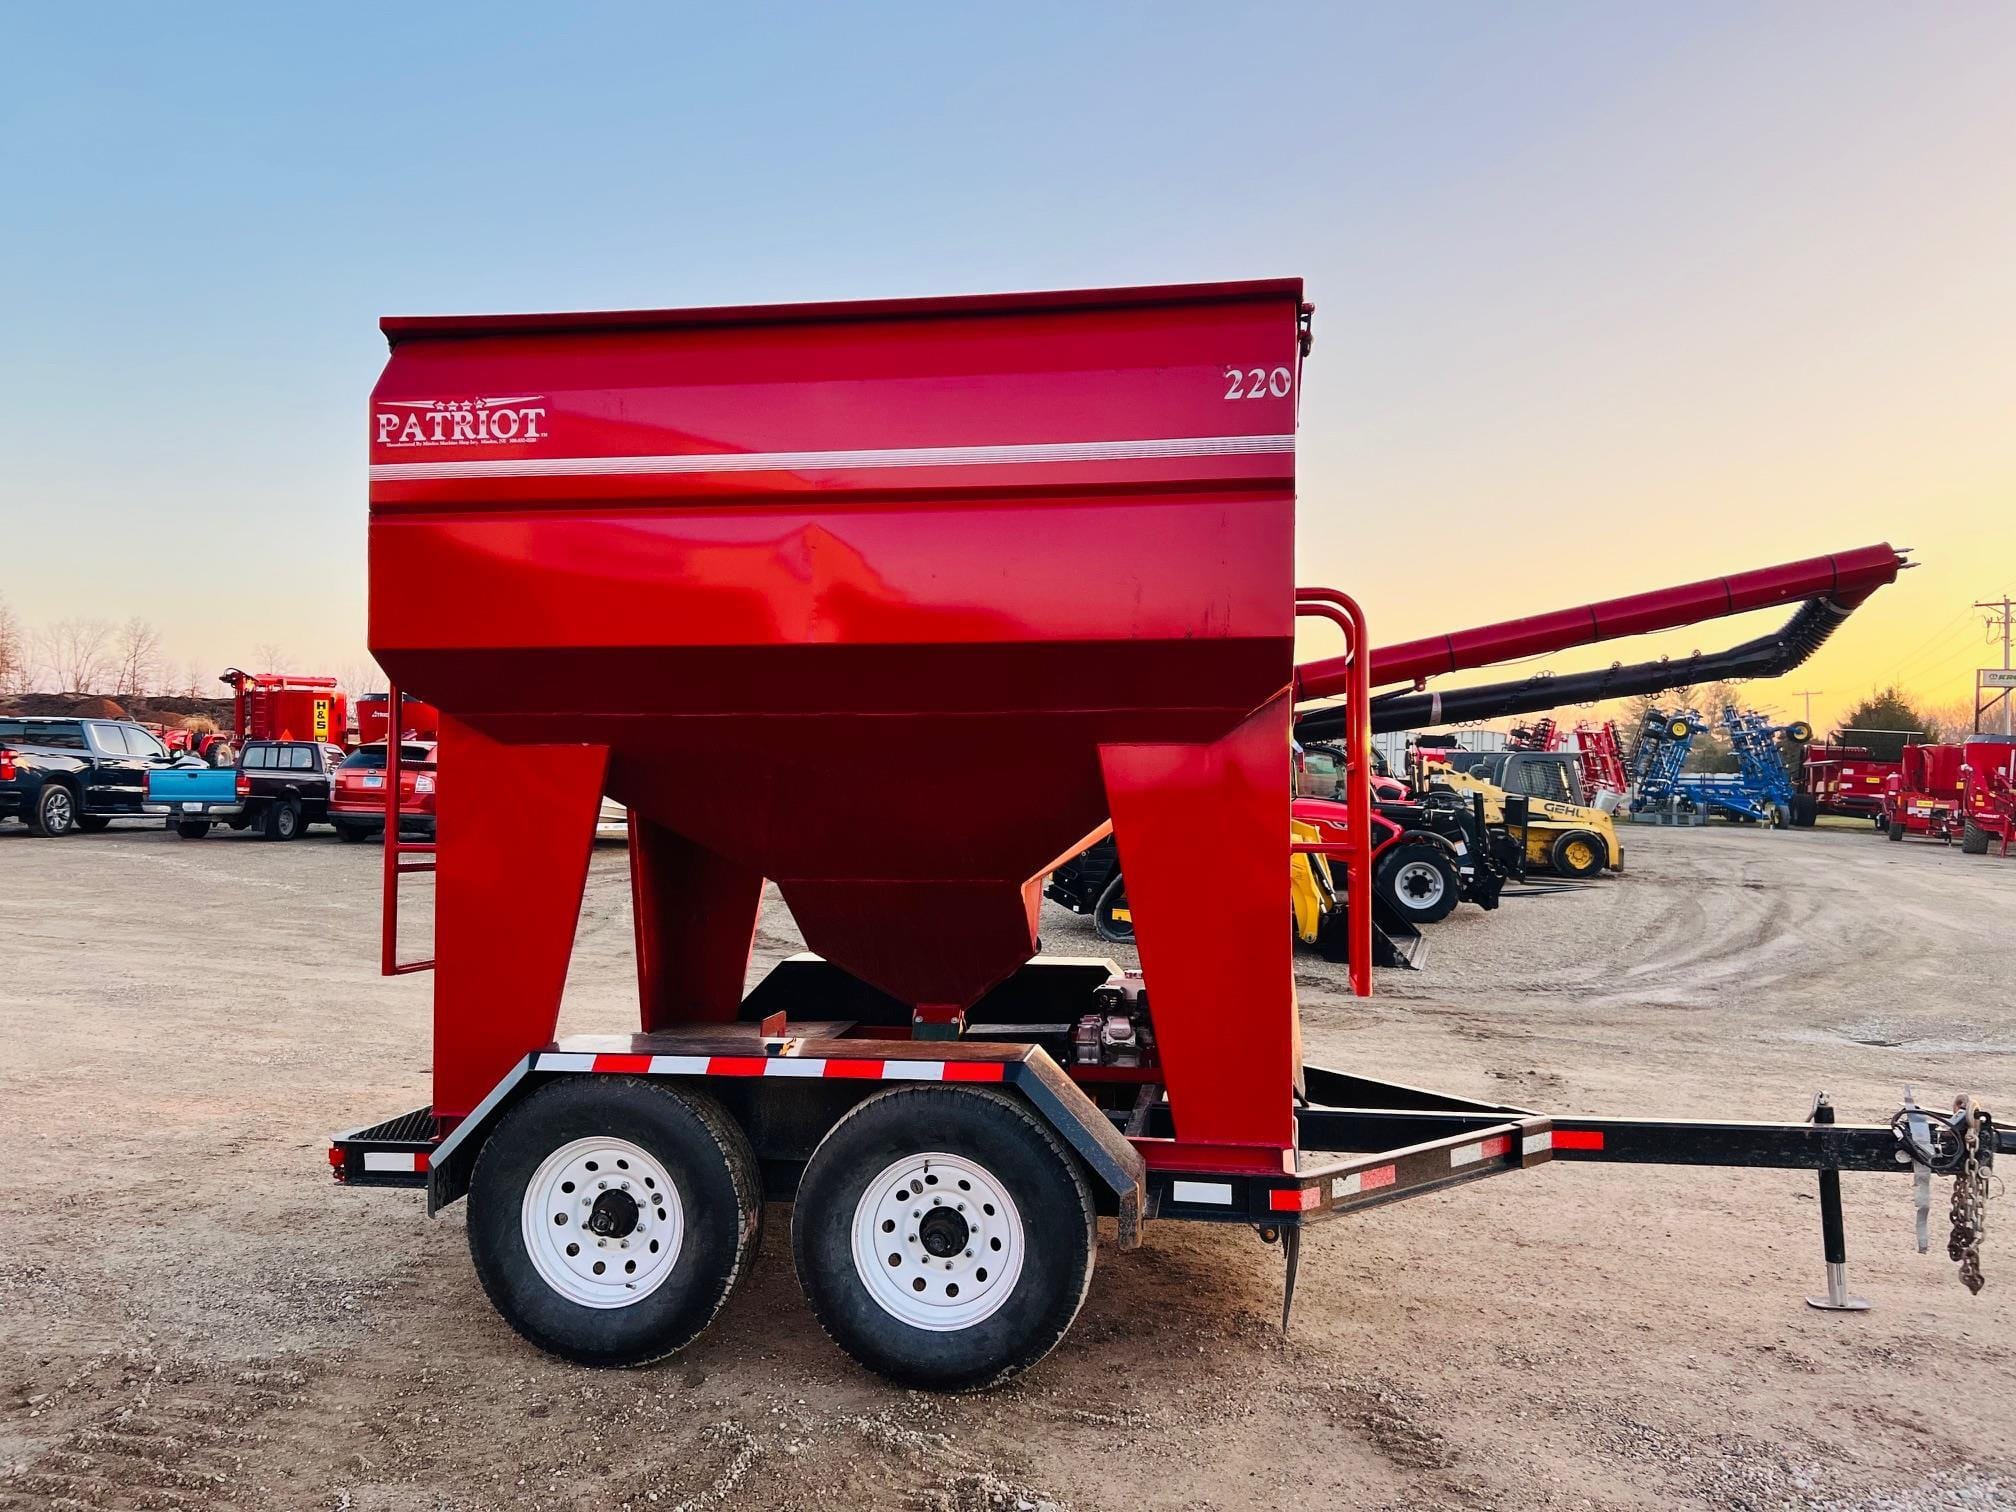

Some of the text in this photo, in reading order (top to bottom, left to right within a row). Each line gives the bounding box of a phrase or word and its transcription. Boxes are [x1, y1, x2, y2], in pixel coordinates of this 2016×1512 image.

[1223, 366, 1292, 400] 220
[376, 408, 546, 443] PATRIOT
[316, 701, 326, 730] H&S
[1543, 802, 1585, 818] GEHL
